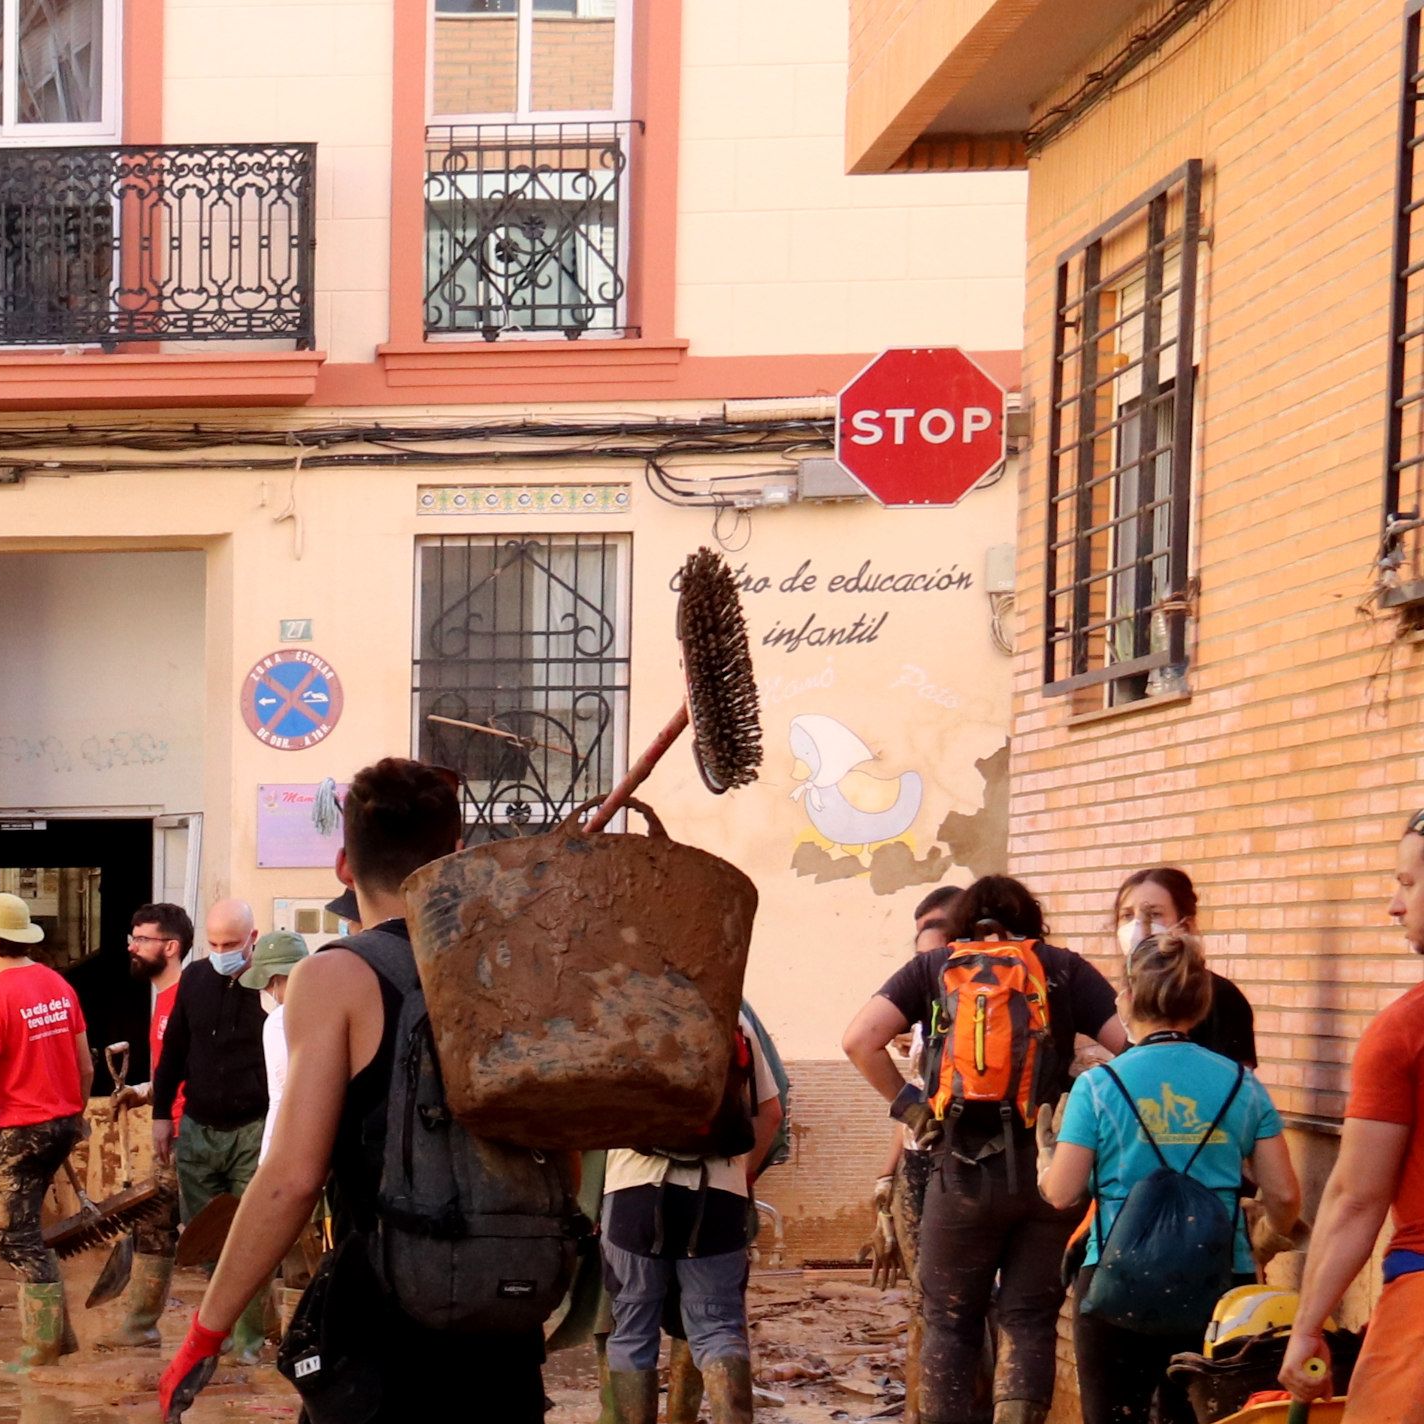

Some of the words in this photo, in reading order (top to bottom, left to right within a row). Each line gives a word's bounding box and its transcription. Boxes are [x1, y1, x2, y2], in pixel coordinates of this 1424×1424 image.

[850, 407, 993, 446] STOP
[779, 559, 817, 593] de
[827, 559, 974, 593] educación
[285, 620, 308, 639] 27
[762, 611, 889, 653] infantil
[251, 653, 282, 681] ZONA
[295, 651, 335, 680] ESCOLAR
[256, 727, 270, 741] DE
[282, 791, 315, 803] Mam
